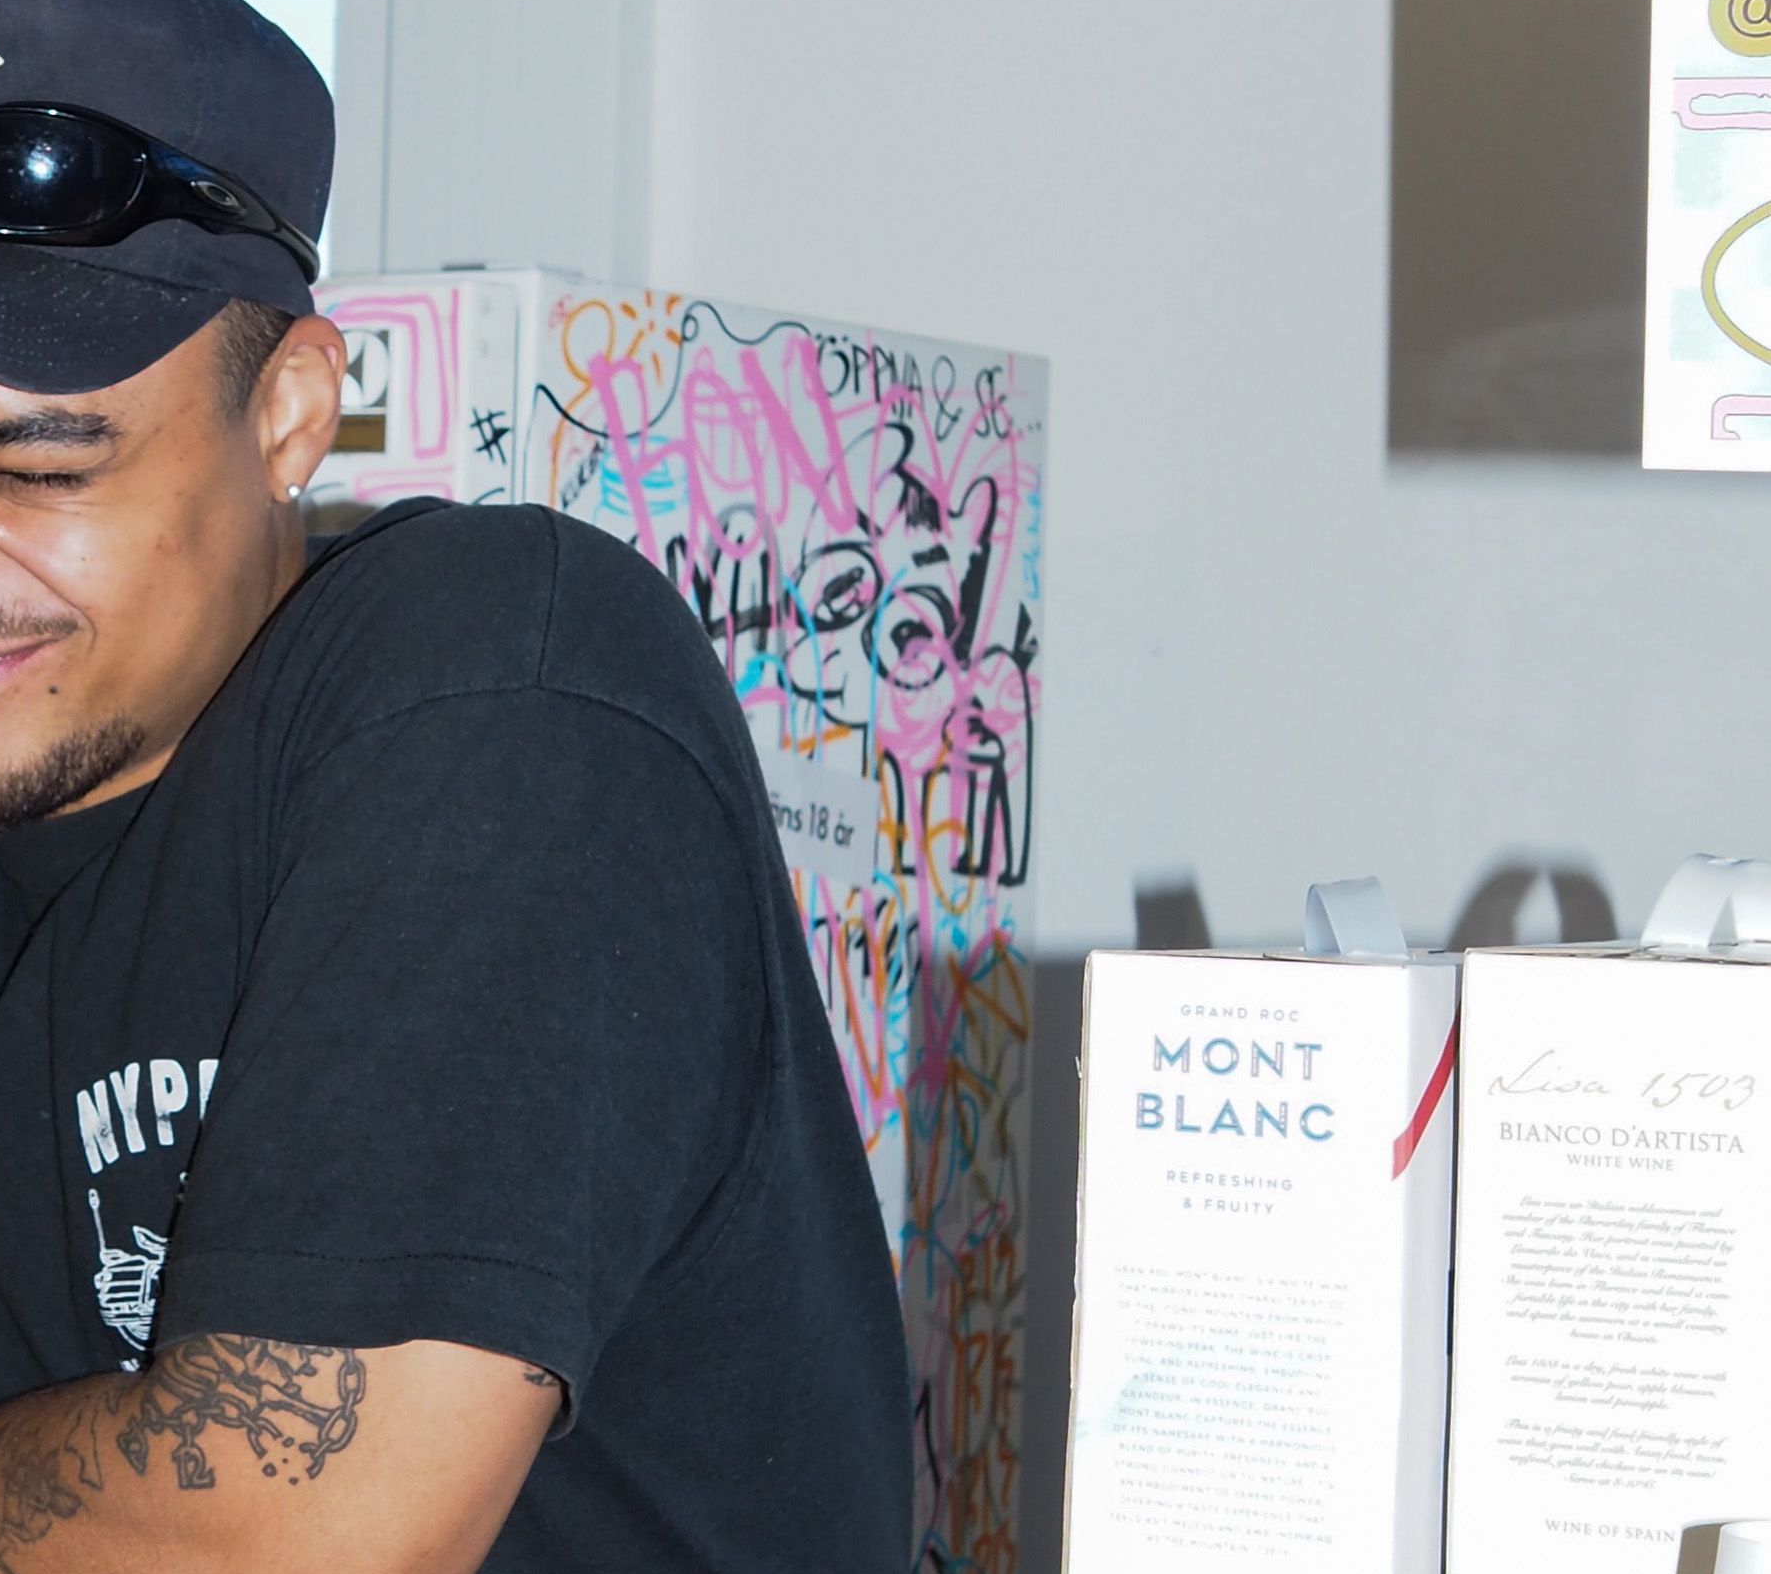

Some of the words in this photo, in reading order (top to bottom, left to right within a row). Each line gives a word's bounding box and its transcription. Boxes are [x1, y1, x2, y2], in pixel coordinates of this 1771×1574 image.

[810, 802, 829, 840] 18
[834, 812, 854, 847] år
[1181, 1005, 1249, 1020] GRAND
[1260, 1008, 1301, 1023] ROC
[1153, 1035, 1323, 1081] MONT
[1640, 1071, 1757, 1110] 1503
[1136, 1092, 1336, 1143] BLANC
[1499, 1123, 1602, 1146] BIANCO
[1611, 1124, 1745, 1154] D'ARTISTA
[1566, 1153, 1623, 1169] WHITE
[1628, 1156, 1675, 1172] WINE
[1166, 1170, 1295, 1192] REFRESHING
[1204, 1199, 1276, 1216] FRUITY
[1545, 1519, 1592, 1535] WINE
[1598, 1524, 1620, 1538] OF
[1626, 1526, 1676, 1543] SPAIN
